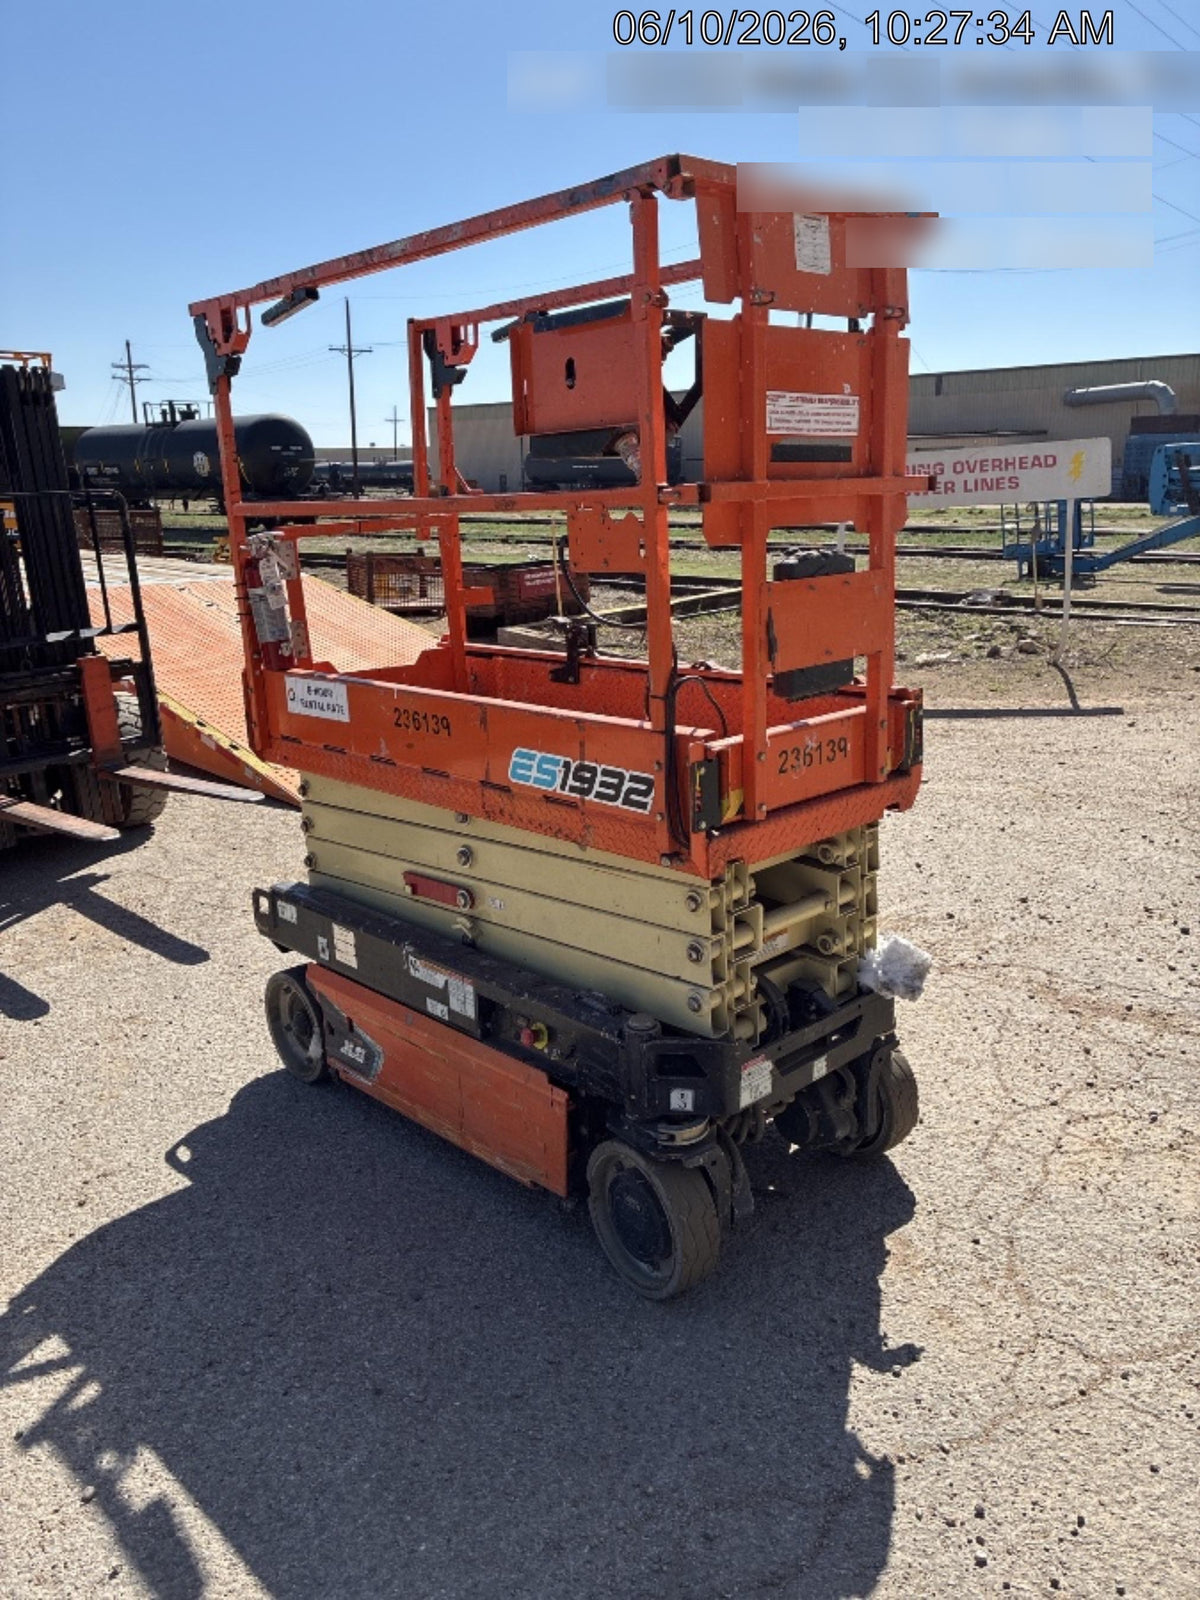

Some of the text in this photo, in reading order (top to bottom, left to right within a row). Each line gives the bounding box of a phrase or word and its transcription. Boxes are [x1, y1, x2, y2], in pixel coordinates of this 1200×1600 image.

[952, 454, 1057, 476] OVERHEAD
[963, 476, 1020, 493] LINES
[393, 707, 451, 737] 236139
[778, 737, 848, 775] 236139
[509, 748, 655, 813] ES1932
